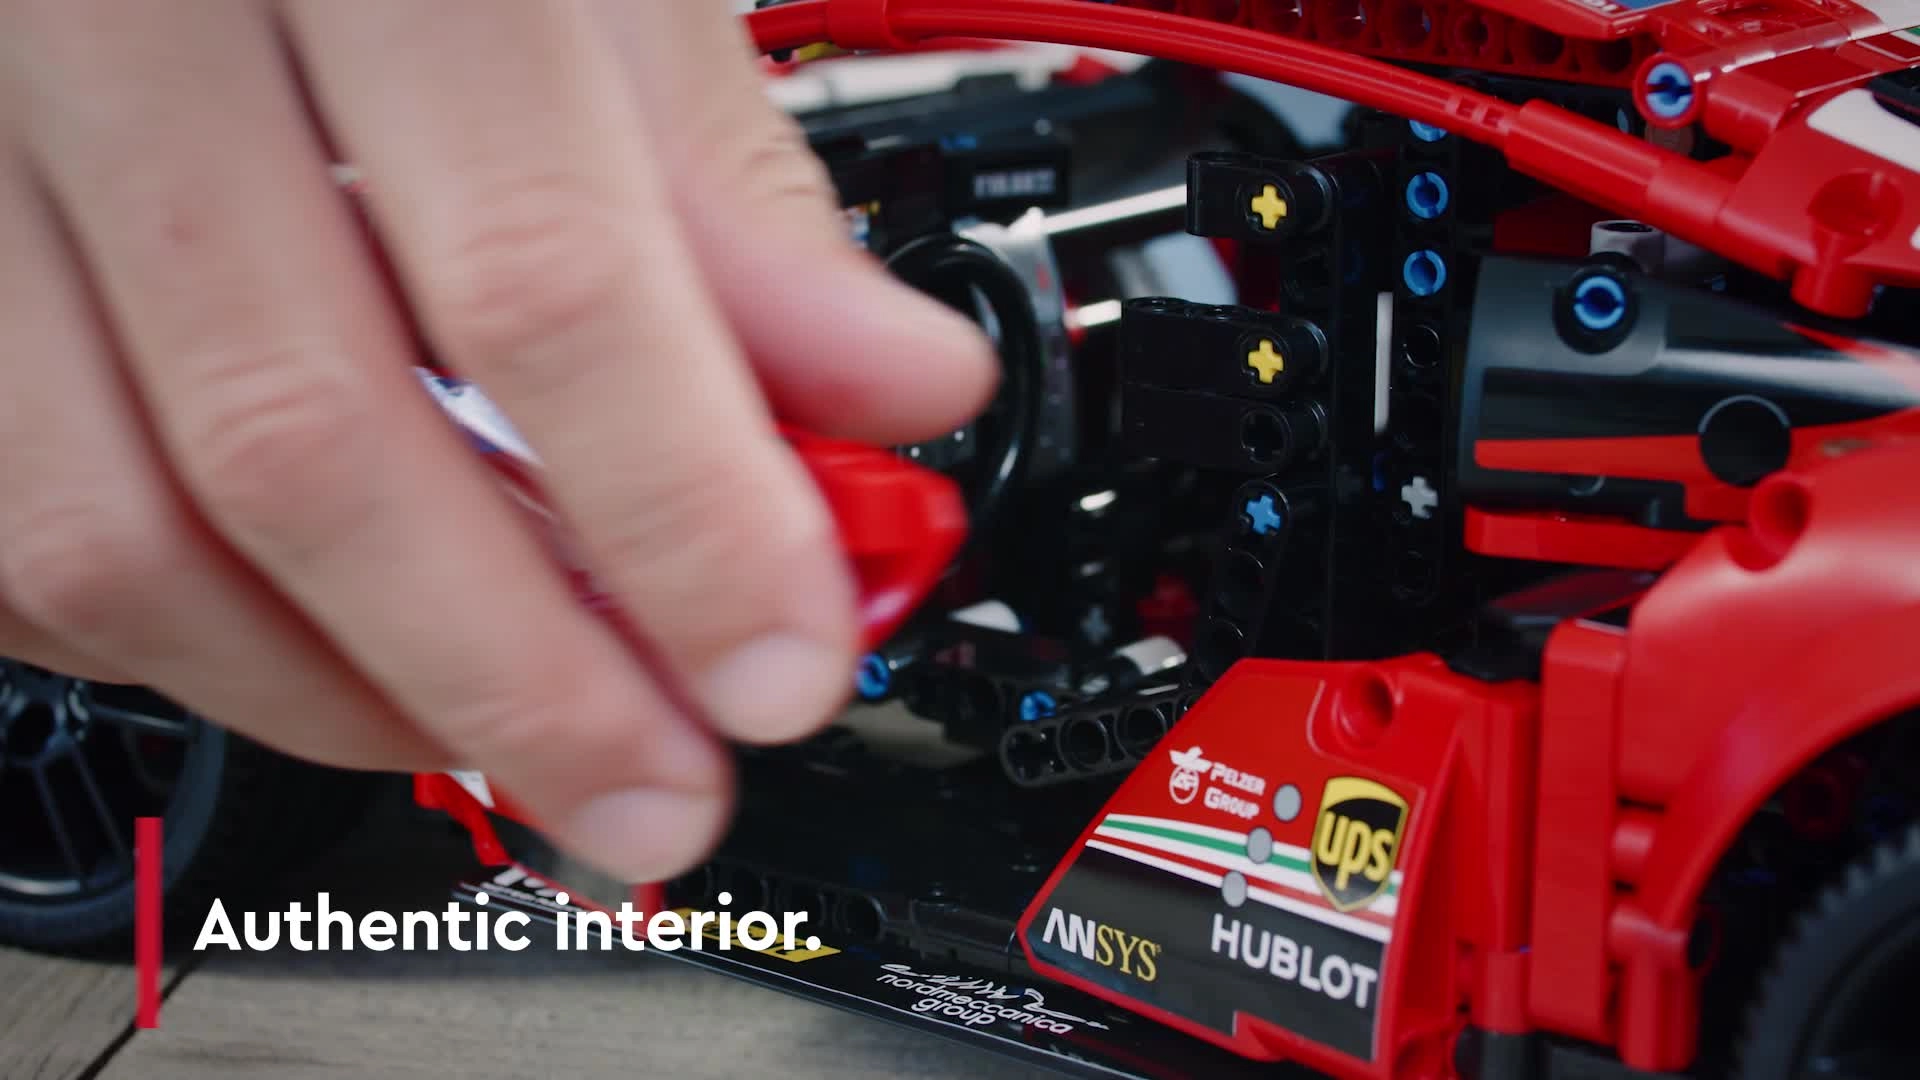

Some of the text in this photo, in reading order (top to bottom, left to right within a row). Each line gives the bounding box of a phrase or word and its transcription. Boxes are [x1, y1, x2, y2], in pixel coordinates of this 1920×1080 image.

[1316, 813, 1396, 890] ups
[1042, 907, 1160, 982] ANSYS
[1210, 913, 1379, 1009] HUBLOT
[876, 973, 1074, 1034] nordmeccanica
[911, 998, 996, 1026] group
